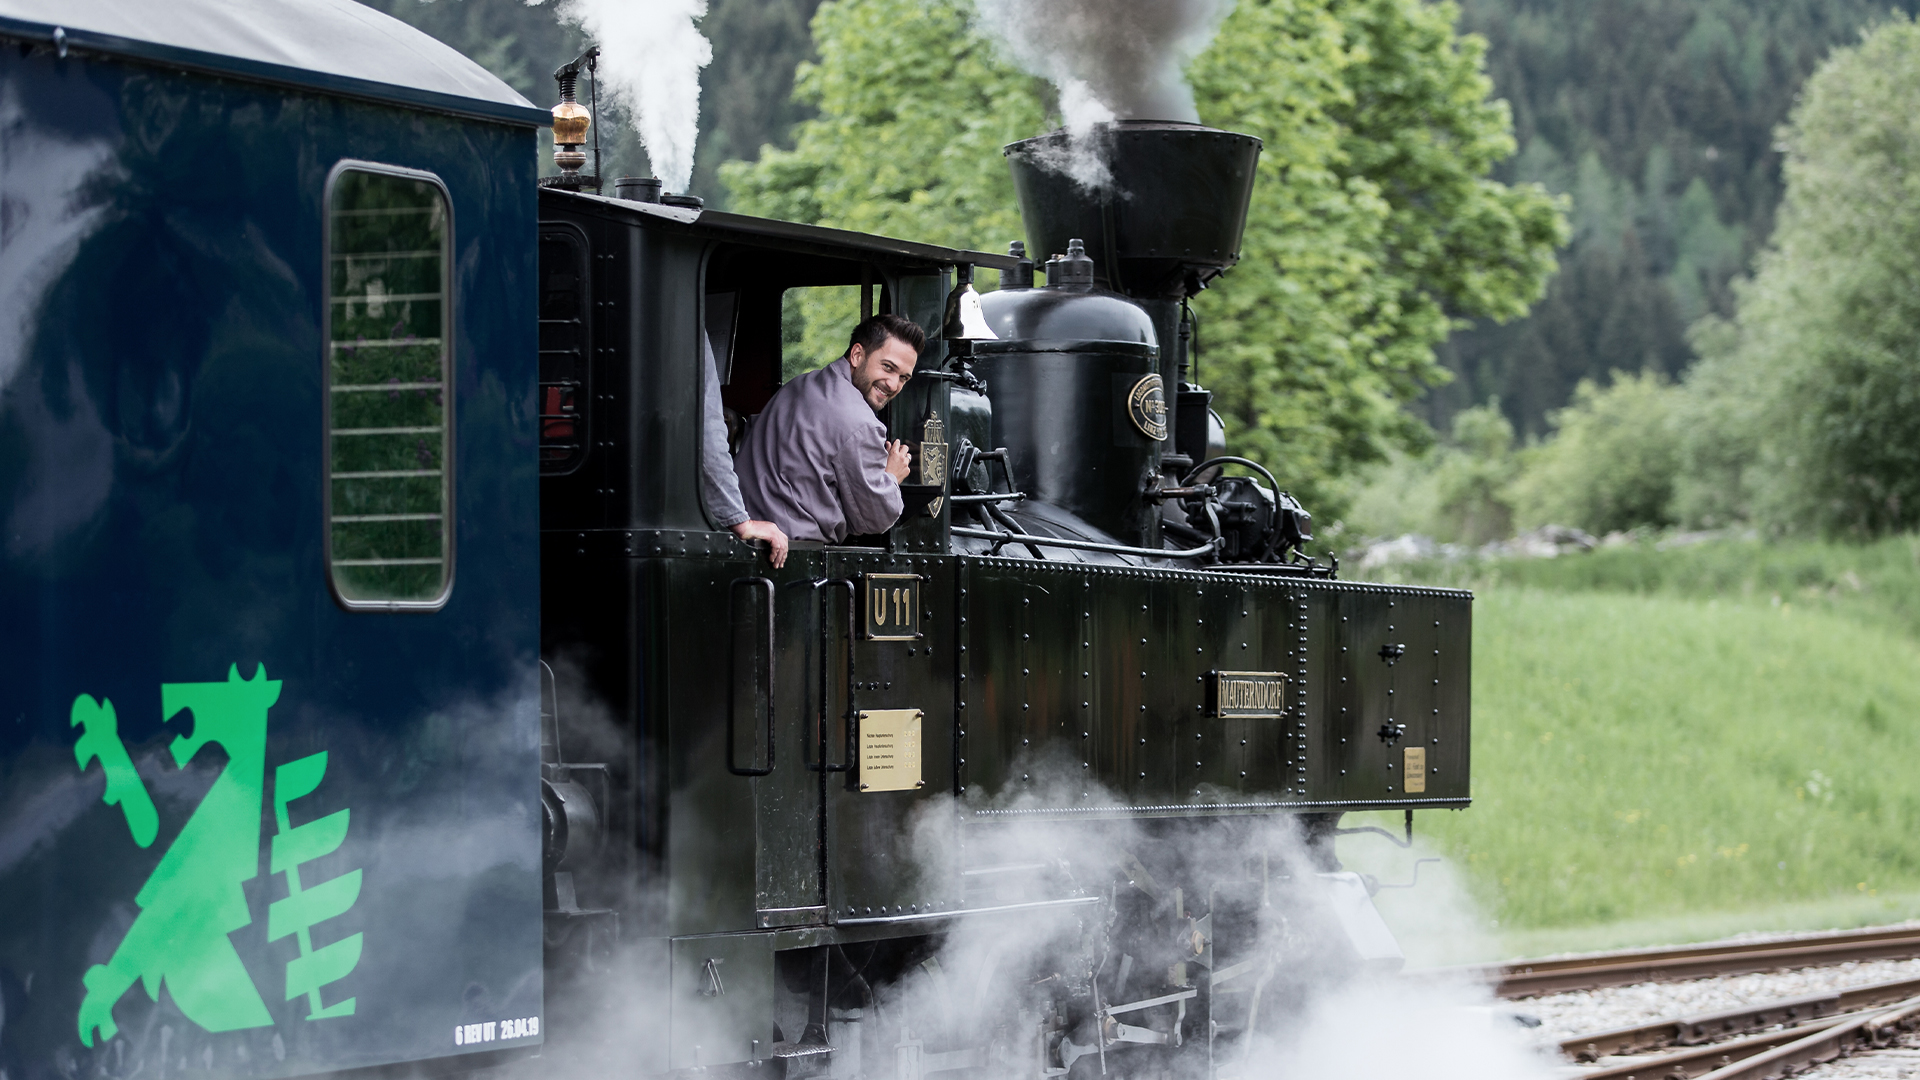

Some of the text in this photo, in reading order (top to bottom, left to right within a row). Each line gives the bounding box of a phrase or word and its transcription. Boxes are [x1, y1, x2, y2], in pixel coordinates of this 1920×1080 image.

[874, 588, 910, 626] U 11
[1221, 680, 1281, 709] MAUTERNDORF
[455, 1016, 539, 1045] 6 REV UT 26.04.19
